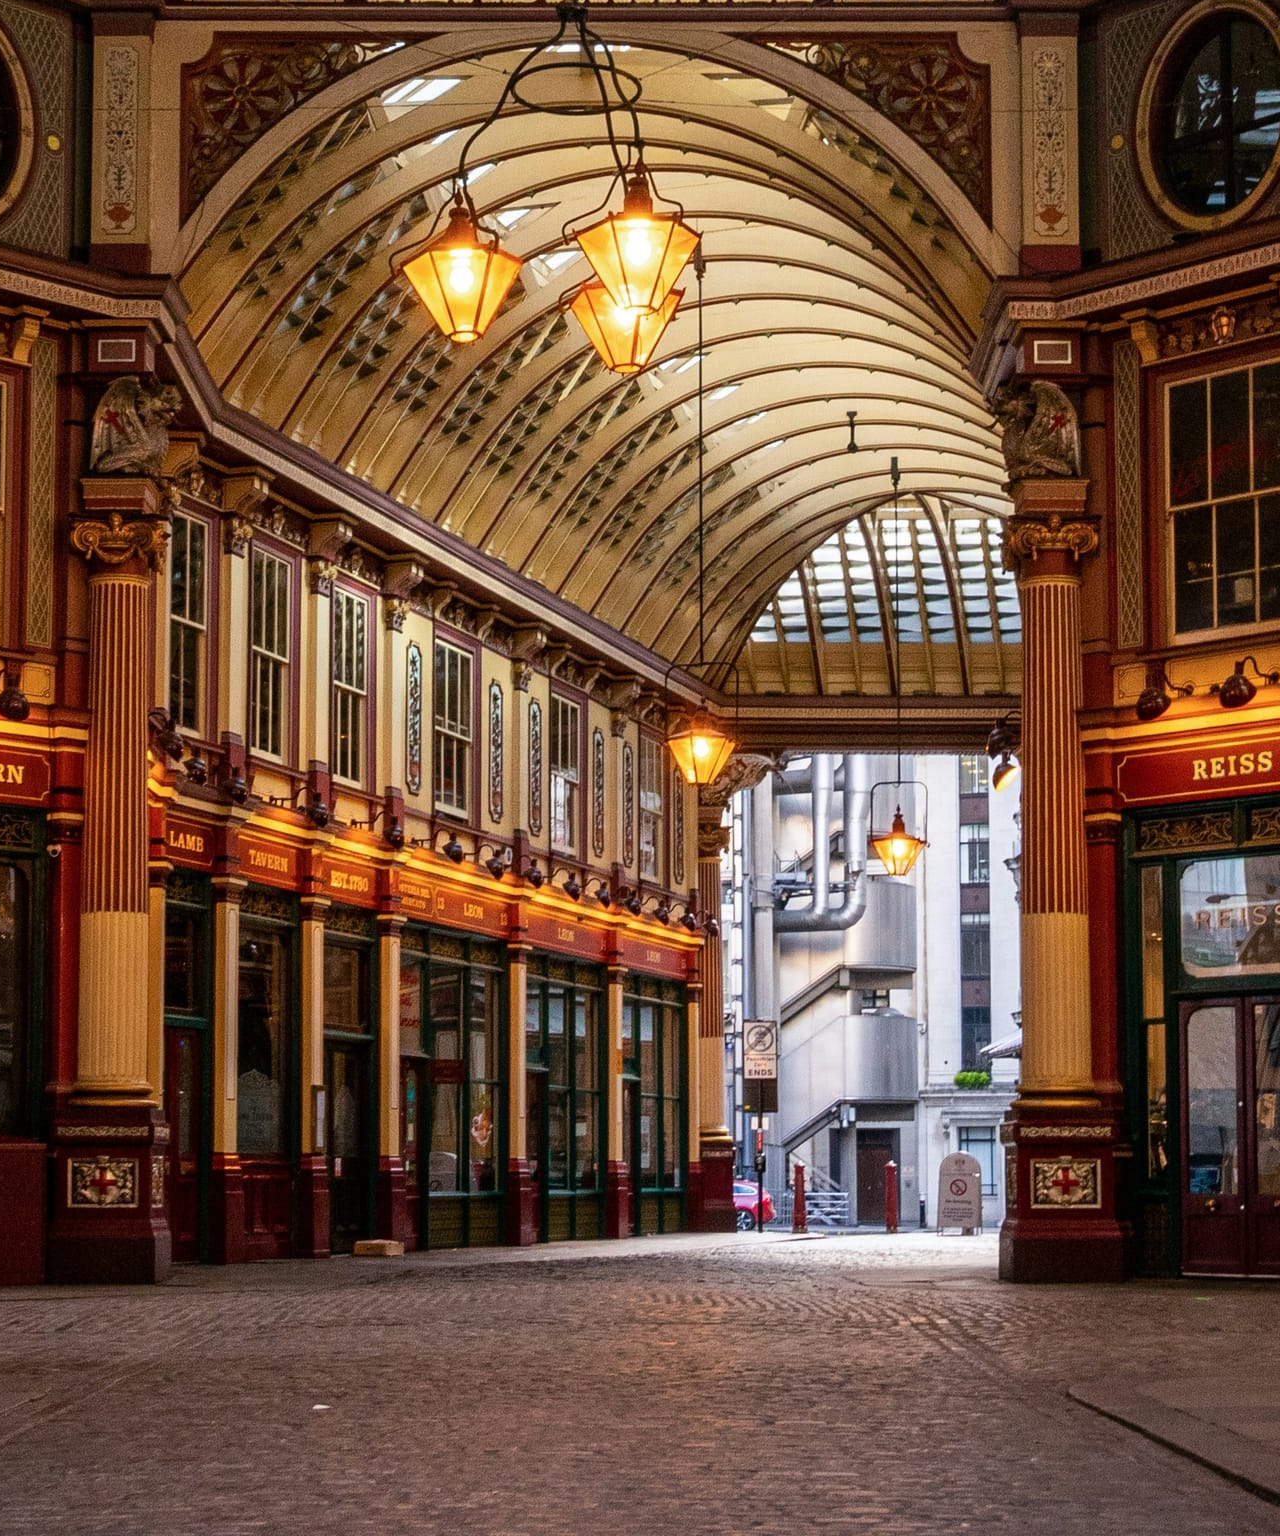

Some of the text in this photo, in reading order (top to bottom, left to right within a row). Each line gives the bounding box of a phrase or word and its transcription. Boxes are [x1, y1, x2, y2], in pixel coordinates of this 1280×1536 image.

[1192, 750, 1273, 782] REISS
[169, 831, 204, 853] LAMB
[248, 849, 289, 873] TAVERN
[463, 902, 484, 920] LEON
[748, 1068, 773, 1076] ENDS
